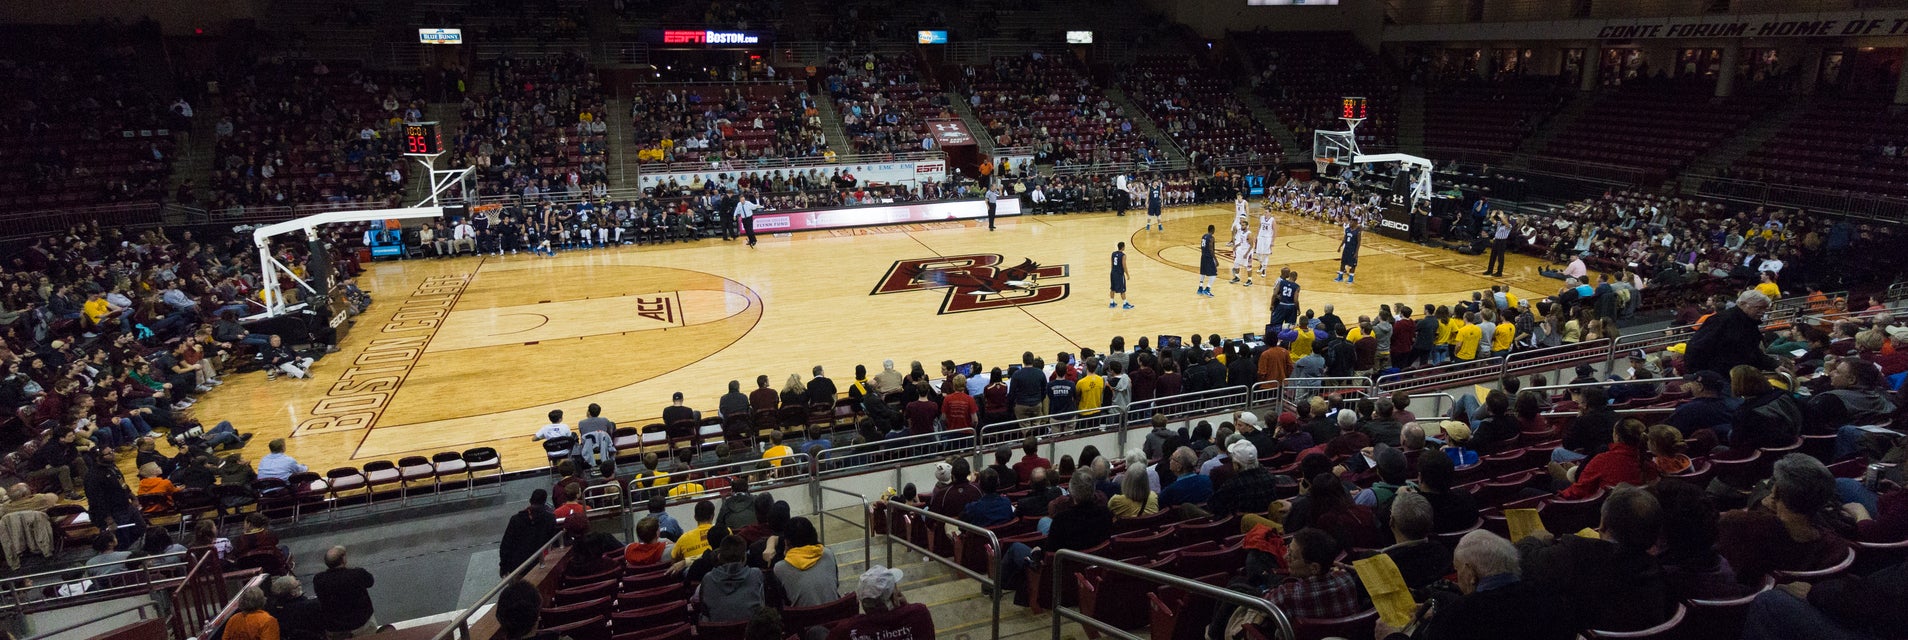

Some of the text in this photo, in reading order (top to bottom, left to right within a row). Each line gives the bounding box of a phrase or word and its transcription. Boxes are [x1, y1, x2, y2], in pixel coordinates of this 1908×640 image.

[1597, 24, 1663, 38] CONTE
[1666, 22, 1748, 37] FORUM
[1757, 20, 1837, 36] HOME
[1840, 18, 1885, 35] OF
[1888, 18, 1908, 34] T
[408, 136, 427, 152] 35
[916, 164, 943, 173] ESPN
[1381, 219, 1409, 231] GEICO
[1282, 286, 1293, 297] 23
[637, 297, 665, 322] ACC
[330, 310, 347, 328] GEICO
[288, 273, 472, 438] BOSTON COLLEGE
[875, 626, 912, 640] Liberty
